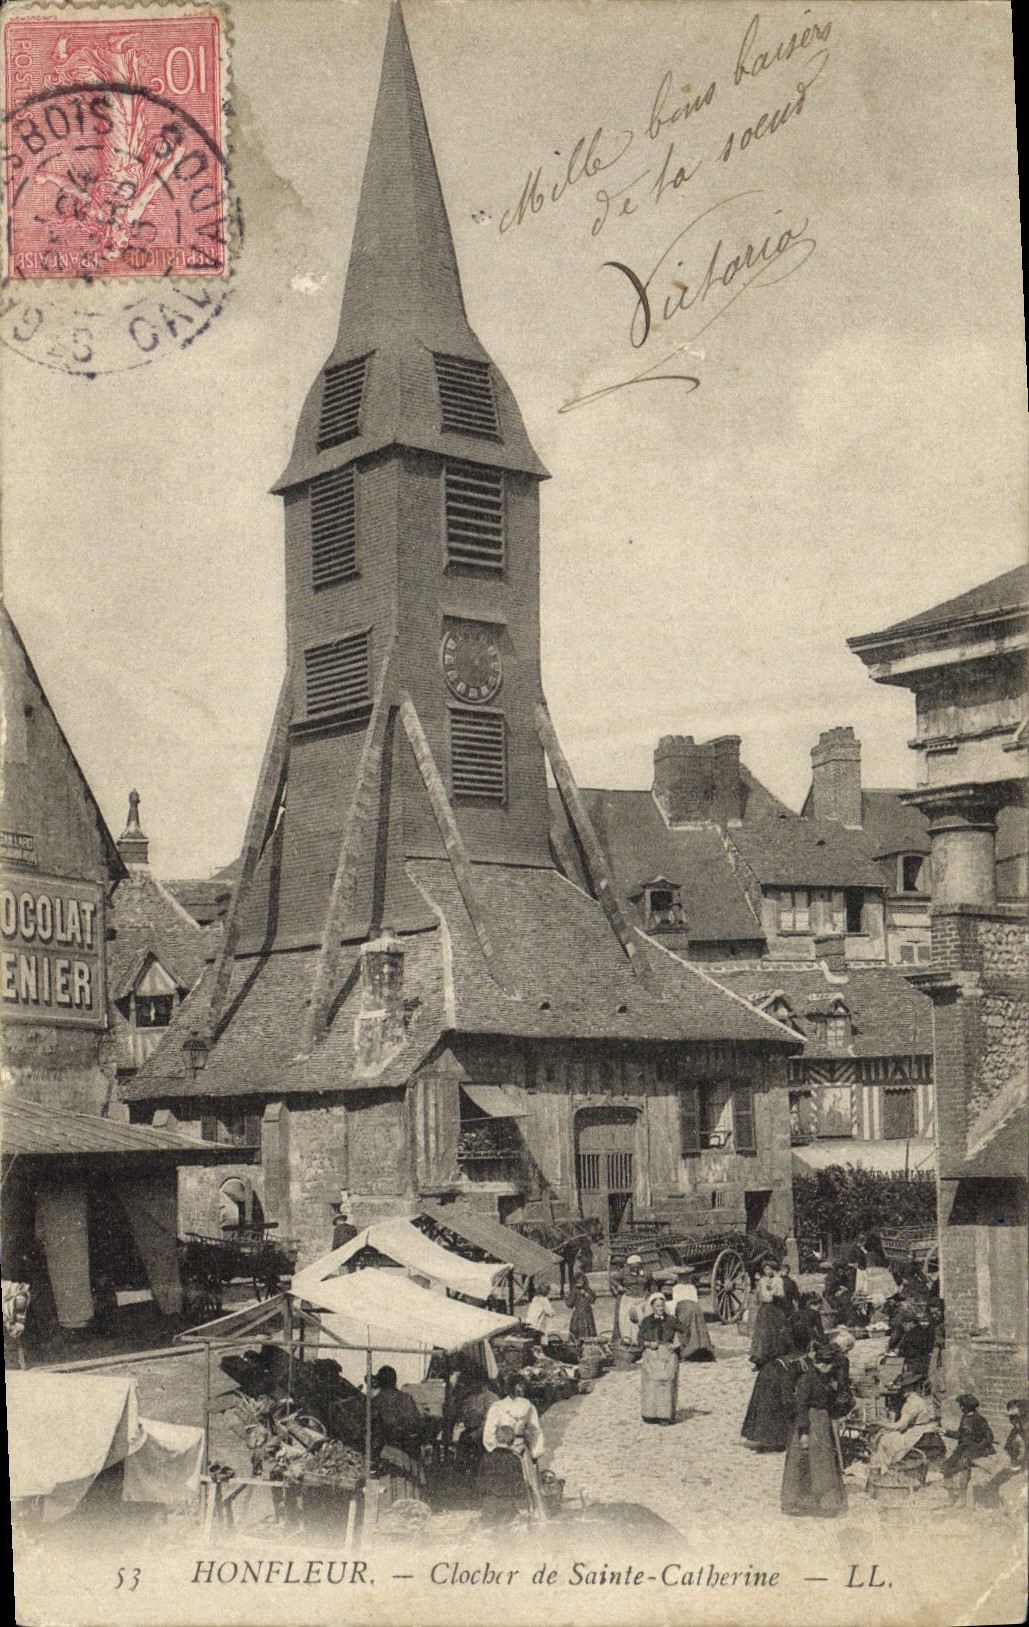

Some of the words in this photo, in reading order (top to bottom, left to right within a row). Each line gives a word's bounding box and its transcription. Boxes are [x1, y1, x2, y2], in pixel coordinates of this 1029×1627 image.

[13, 94, 114, 155] BOIS
[500, 127, 633, 233] Mille
[734, 9, 832, 85] baisers
[592, 170, 650, 236] de
[604, 190, 816, 348] Victoria
[0, 890, 96, 949] OCOLAT
[0, 952, 93, 1010] ENIER
